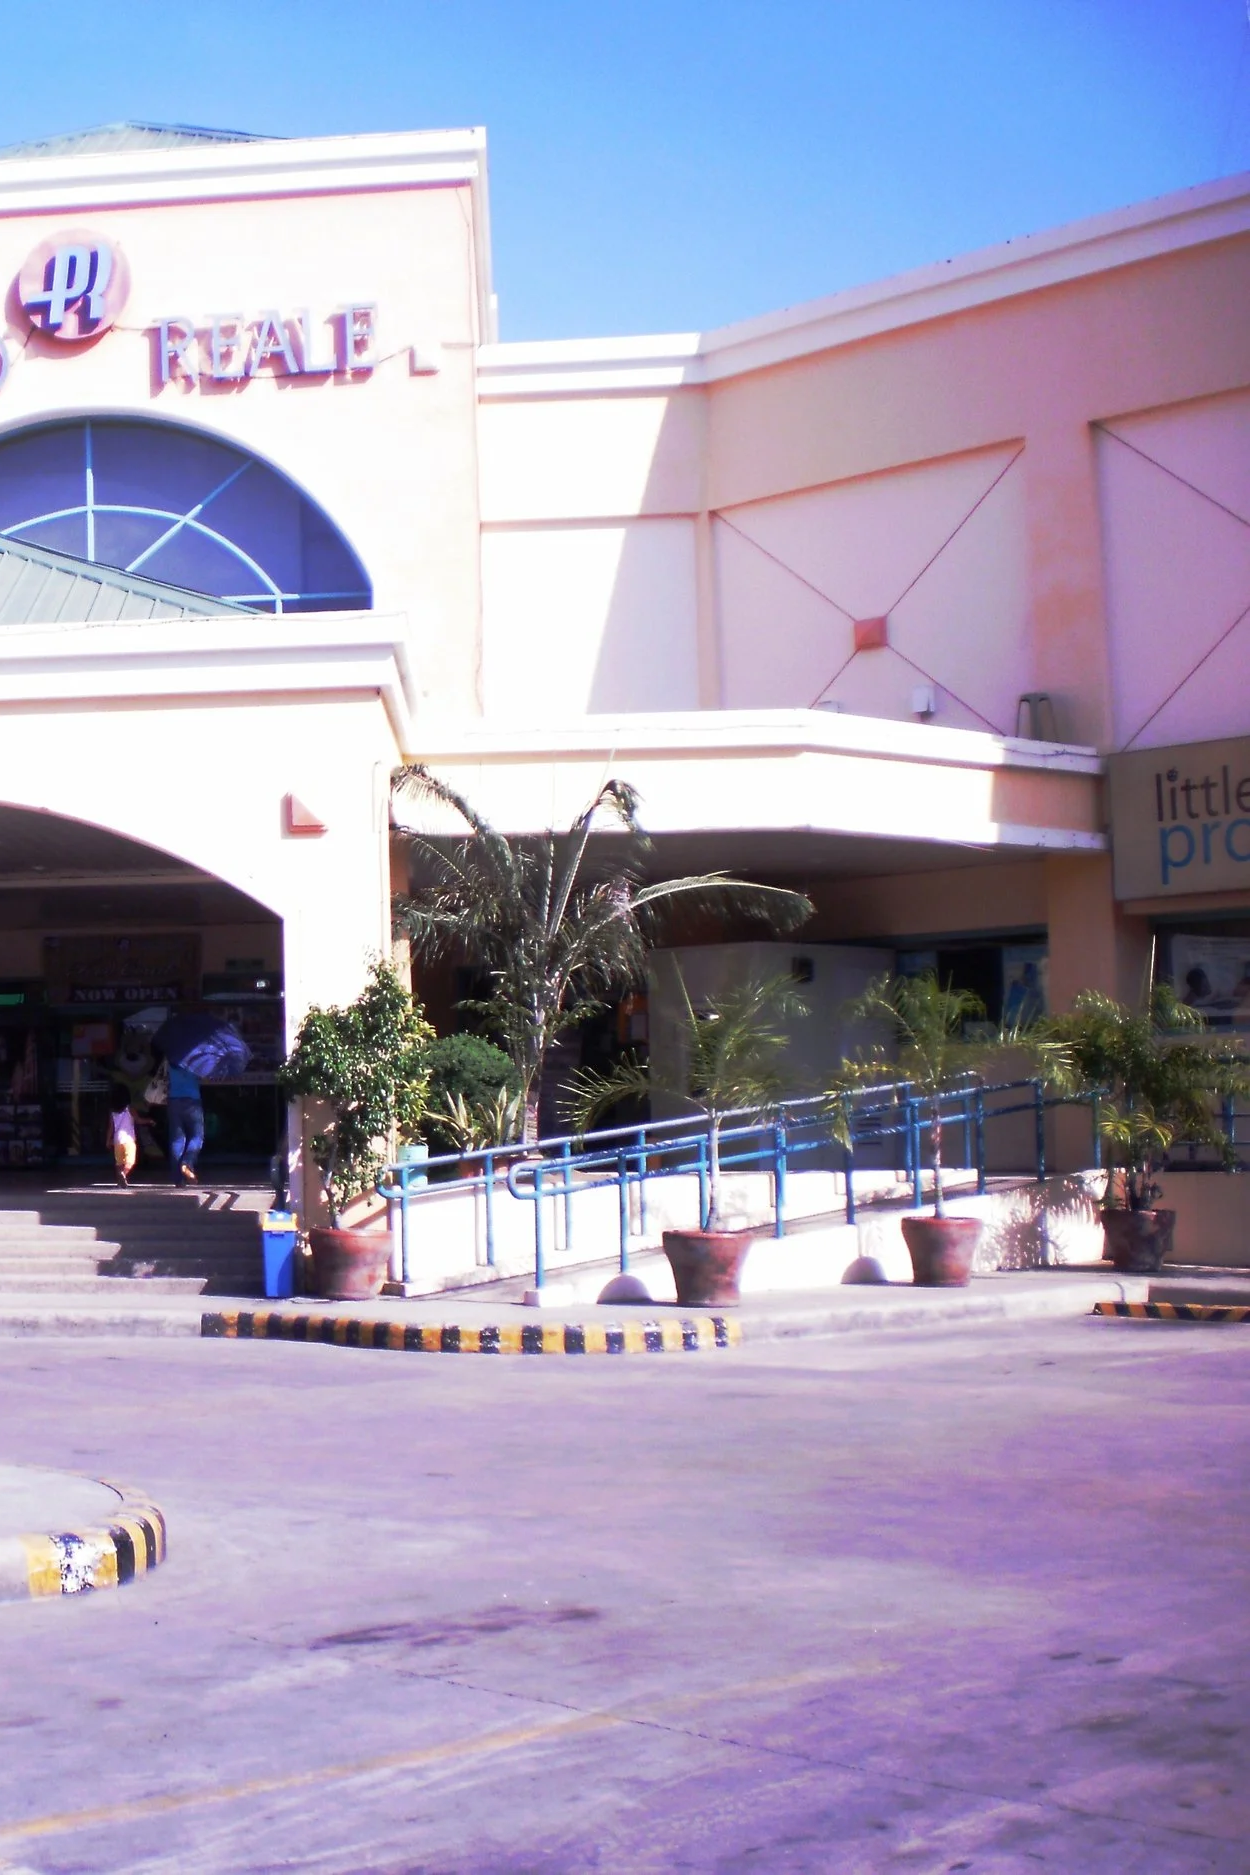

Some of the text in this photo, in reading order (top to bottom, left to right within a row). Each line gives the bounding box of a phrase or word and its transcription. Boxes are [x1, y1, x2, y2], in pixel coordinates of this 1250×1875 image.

[152, 302, 378, 383] REALE
[1155, 765, 1250, 822] little
[74, 986, 178, 1001] NOW OPEN
